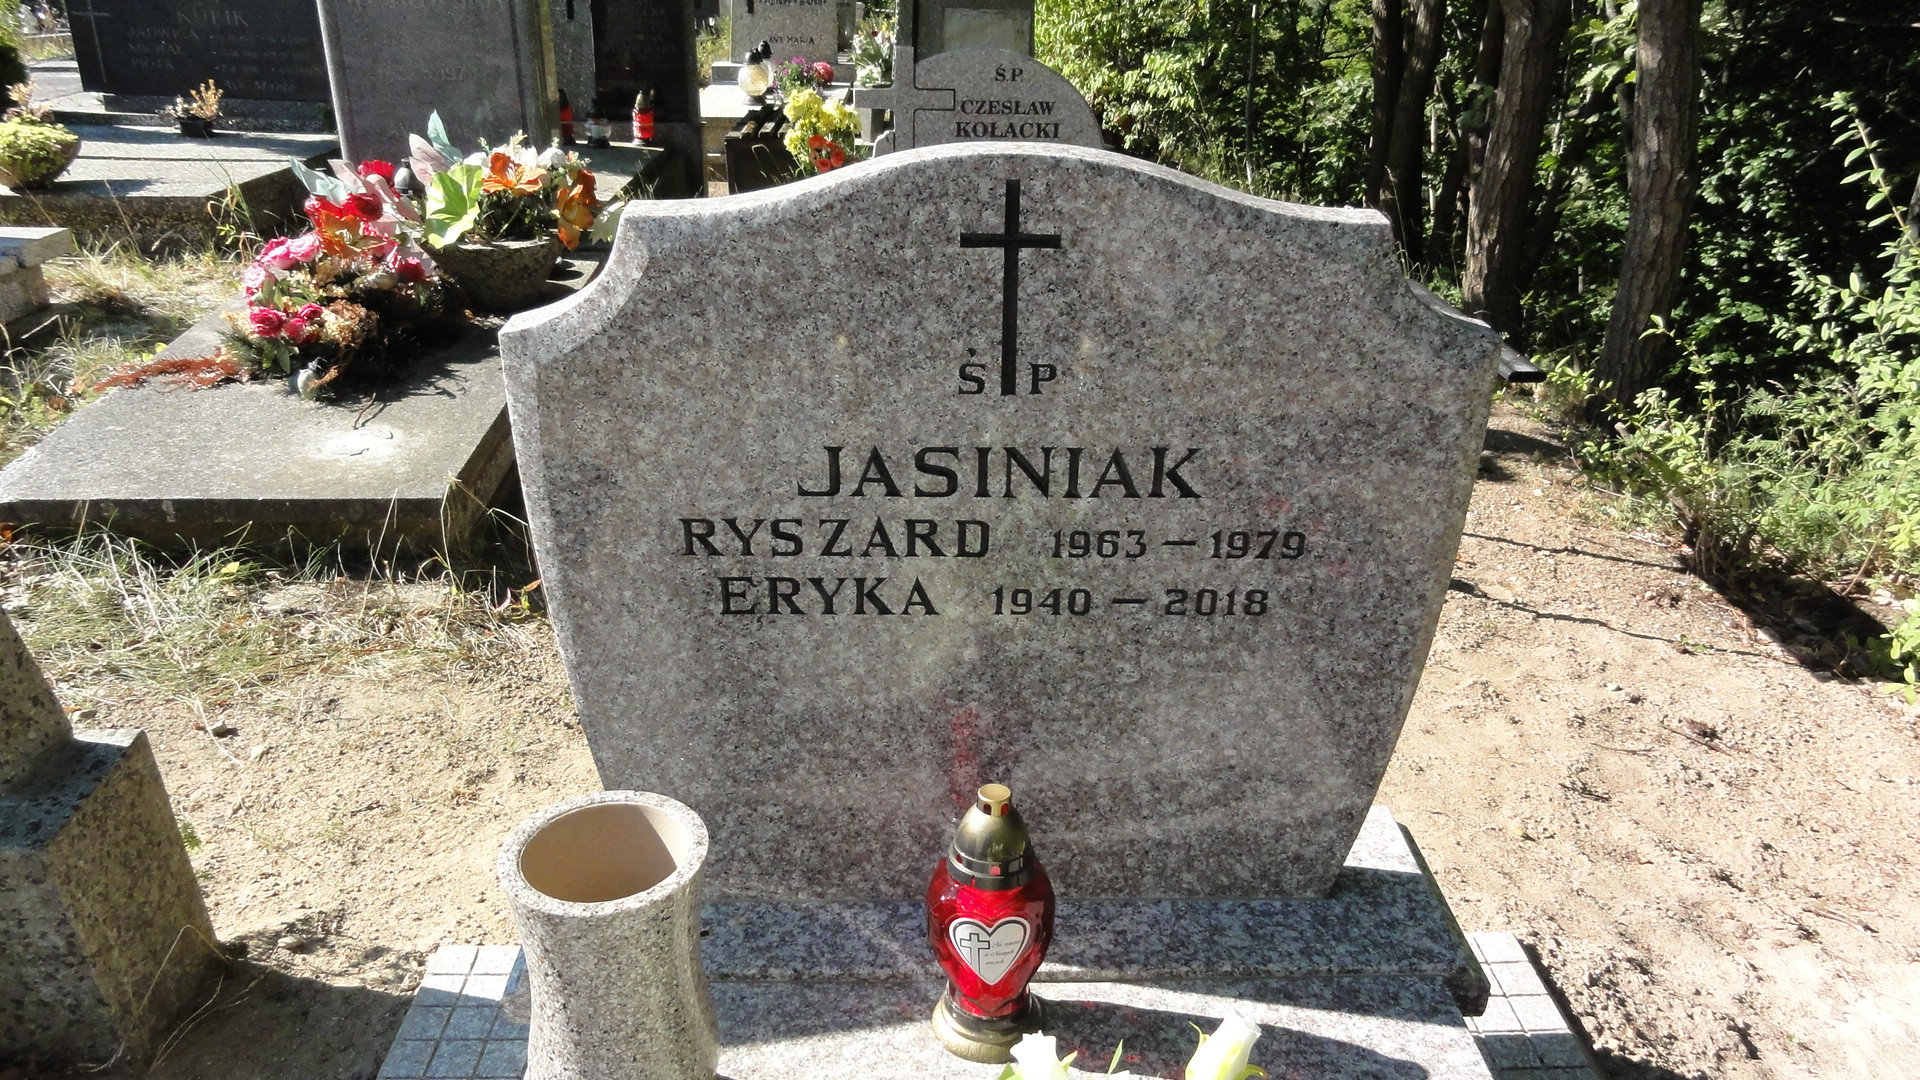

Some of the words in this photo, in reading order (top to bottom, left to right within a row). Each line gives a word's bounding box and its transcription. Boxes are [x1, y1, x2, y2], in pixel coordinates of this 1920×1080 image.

[960, 100, 1056, 115] CZESŁAW
[956, 121, 1061, 139] KOŁACKI
[1028, 361, 1058, 395] P
[797, 445, 1202, 499] JASINIAK
[678, 518, 991, 558] RYSZARD
[1052, 530, 1147, 559] 1963
[1209, 530, 1307, 560] 1979
[718, 576, 940, 616] ERYKA
[993, 587, 1092, 616] 1940
[1164, 588, 1269, 617] 2018
